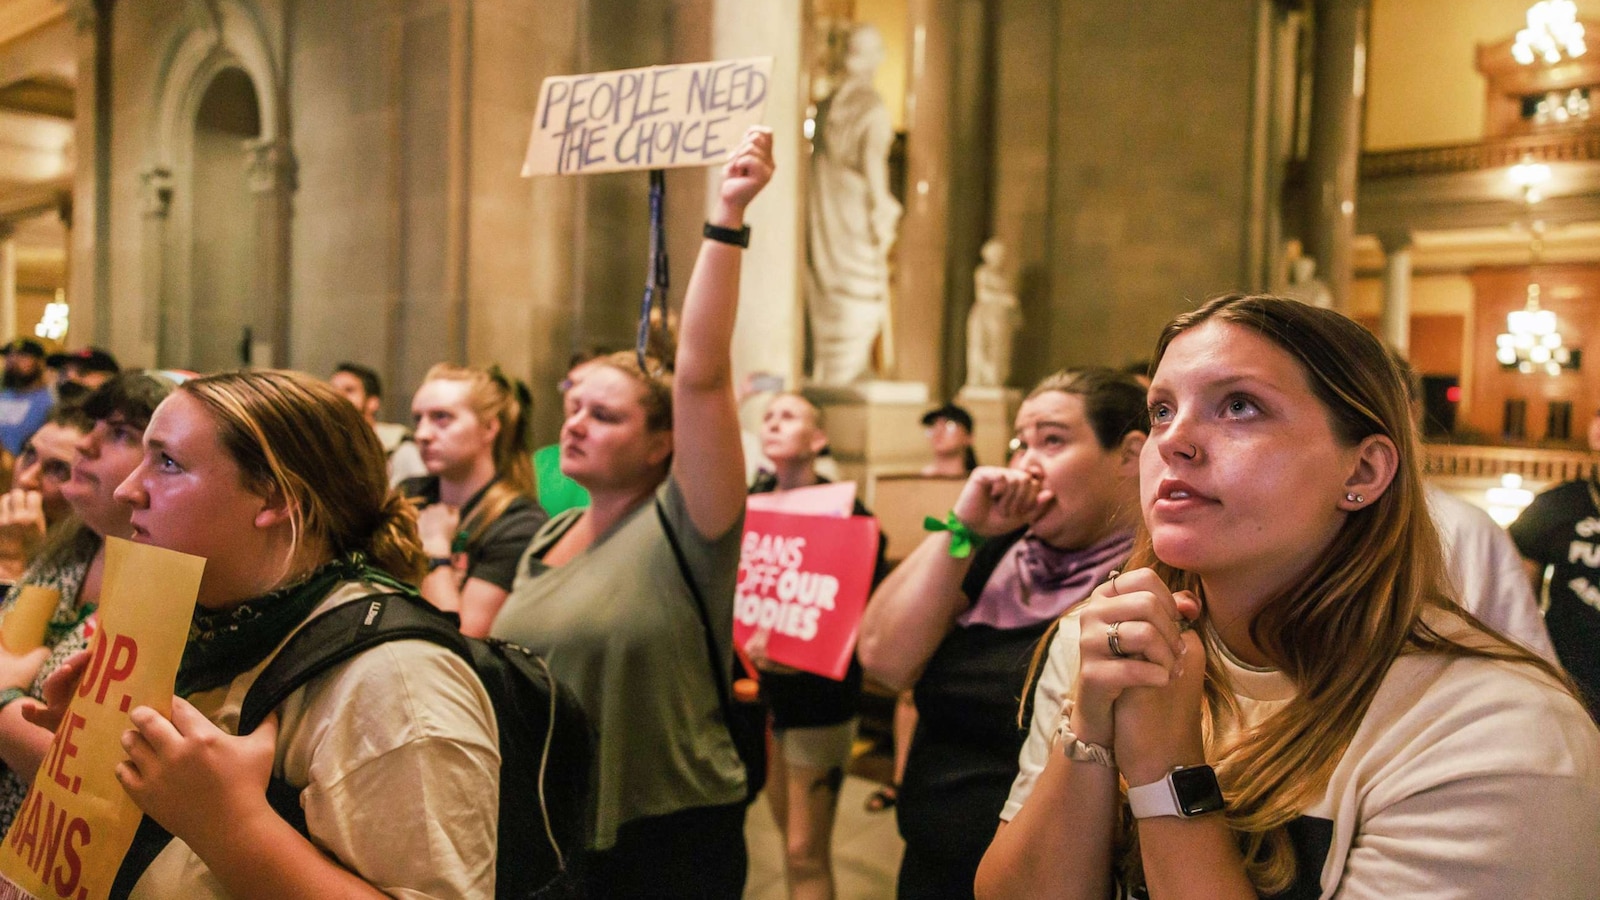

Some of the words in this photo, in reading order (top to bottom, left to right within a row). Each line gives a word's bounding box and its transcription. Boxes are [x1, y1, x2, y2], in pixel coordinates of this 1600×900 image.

[541, 68, 679, 131] PEOPLE
[687, 63, 767, 114] NEED
[551, 120, 608, 174] THE
[613, 116, 730, 164] CHOICE
[776, 569, 839, 611] OUR
